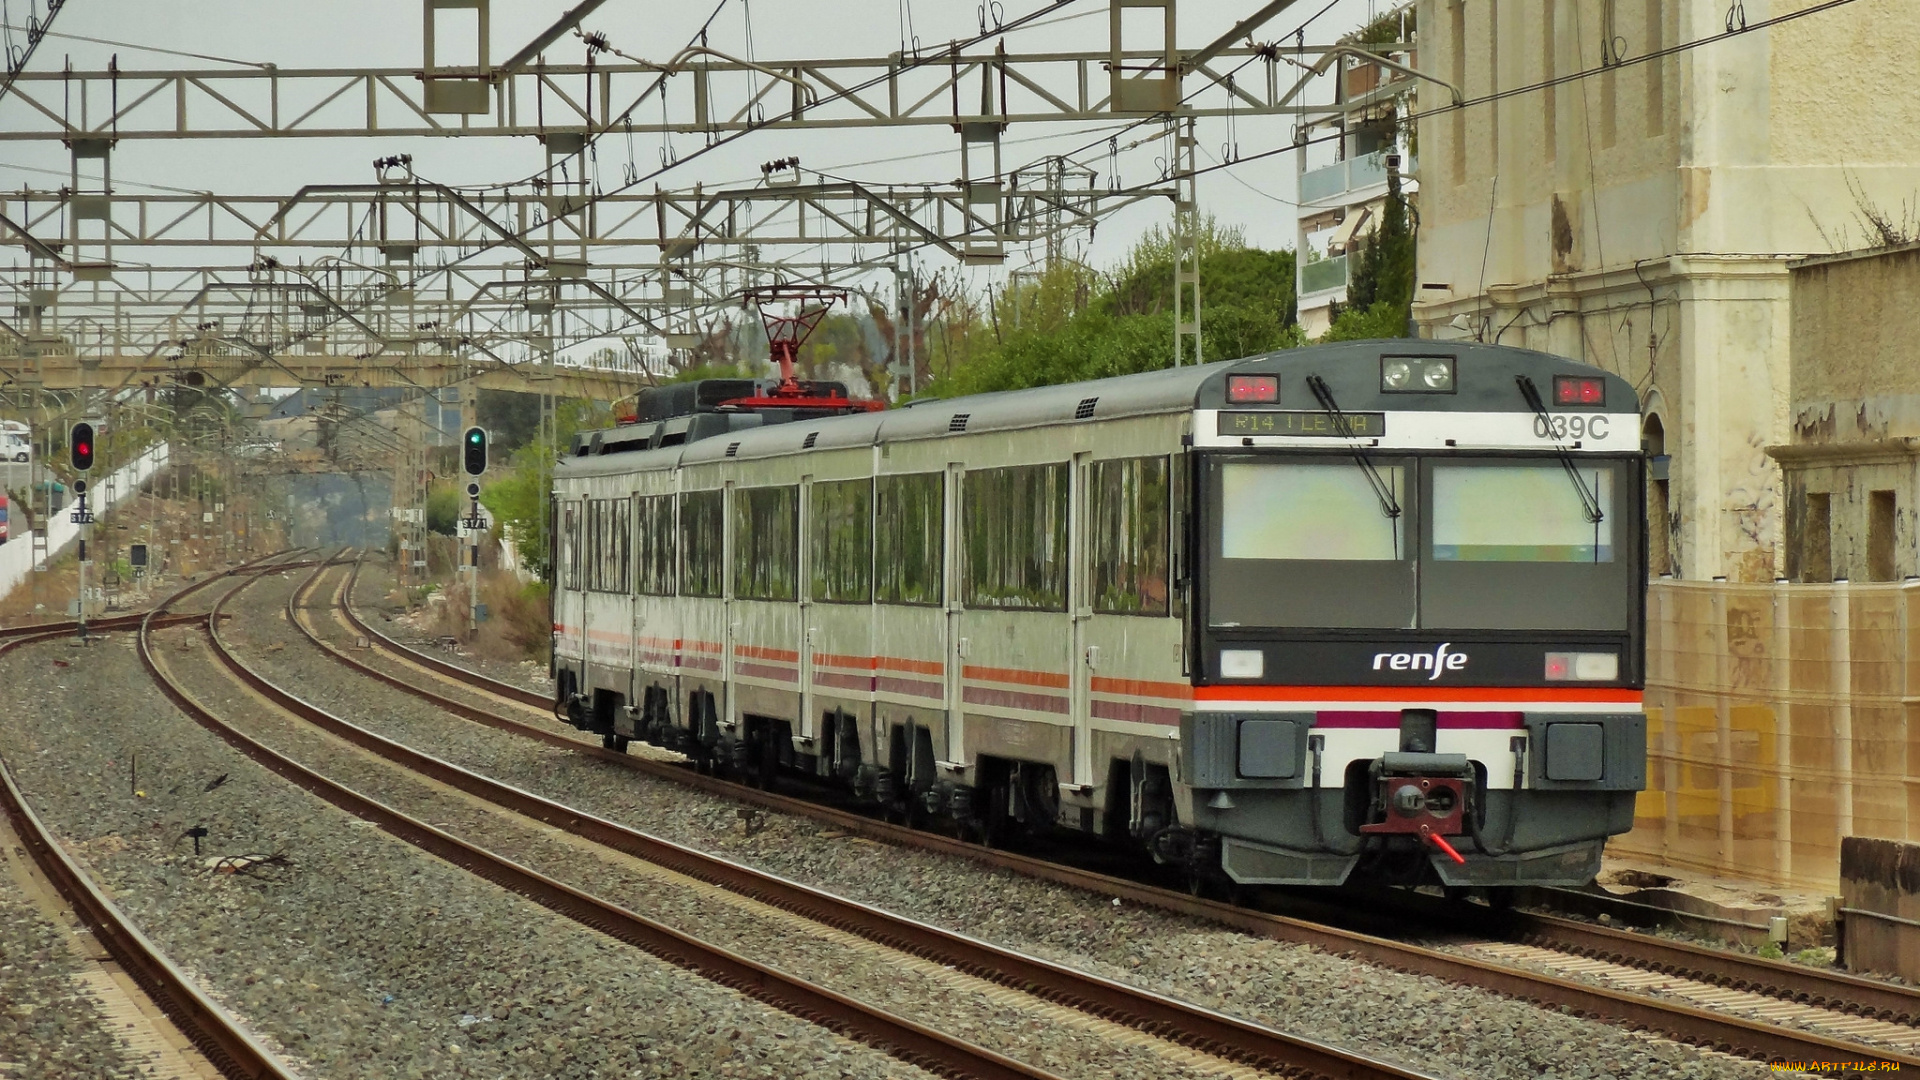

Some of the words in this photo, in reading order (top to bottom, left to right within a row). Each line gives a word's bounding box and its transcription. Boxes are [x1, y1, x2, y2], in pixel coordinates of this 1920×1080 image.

[1235, 414, 1274, 431] R14
[1533, 414, 1609, 440] 039C
[1372, 642, 1468, 680] renfe
